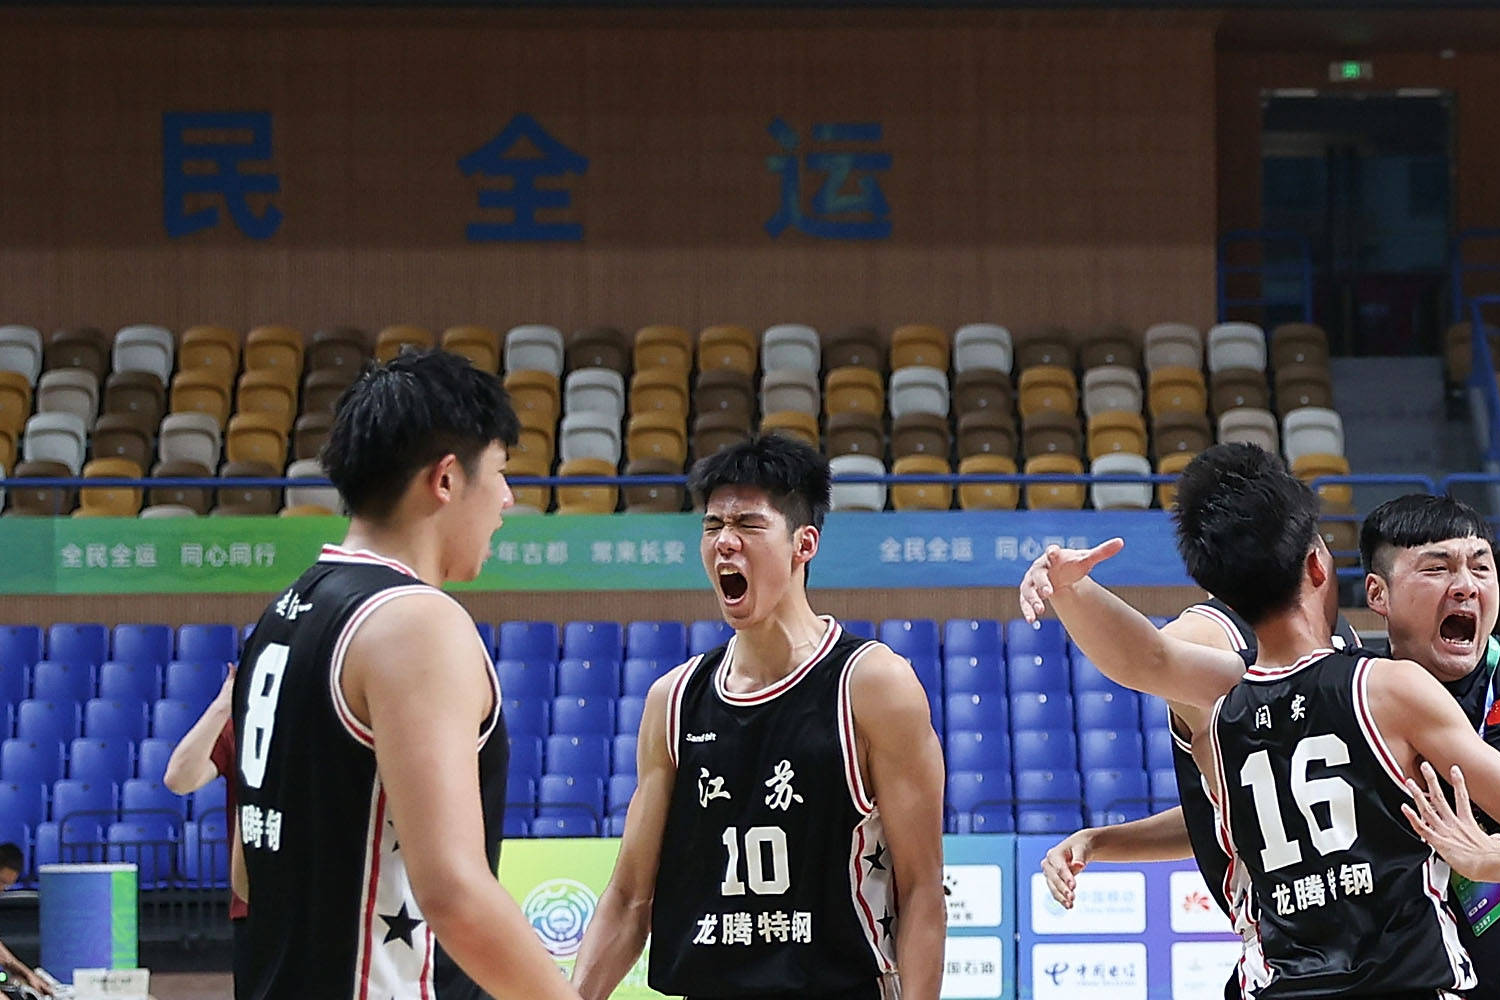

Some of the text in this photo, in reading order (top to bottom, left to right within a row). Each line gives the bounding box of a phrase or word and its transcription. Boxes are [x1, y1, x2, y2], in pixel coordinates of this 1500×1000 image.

[61, 542, 276, 568] 全民全运 同心同行
[490, 541, 568, 564] 年古都
[880, 536, 974, 562] 全民全运
[241, 642, 290, 788] 8
[698, 759, 804, 811] 江苏
[1240, 734, 1359, 873] 16
[721, 826, 790, 896] 10
[693, 910, 812, 945] 龙腾特钢
